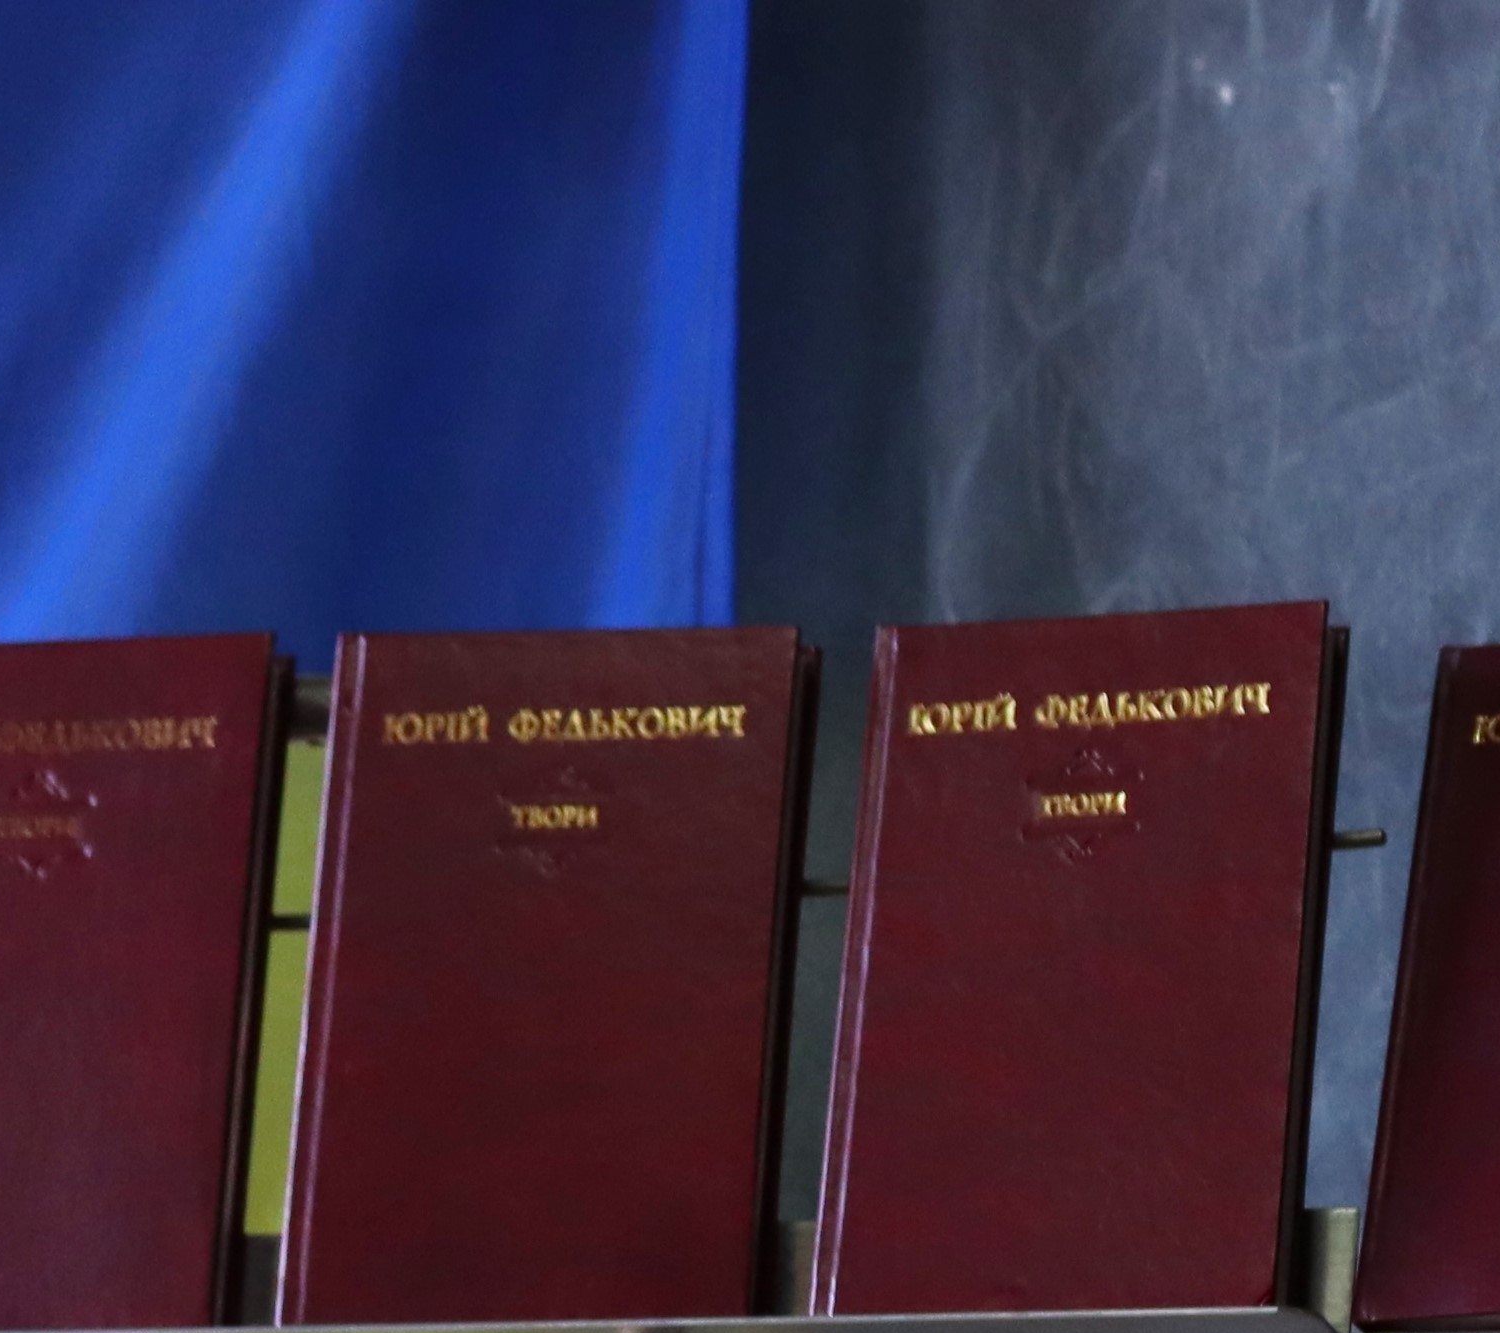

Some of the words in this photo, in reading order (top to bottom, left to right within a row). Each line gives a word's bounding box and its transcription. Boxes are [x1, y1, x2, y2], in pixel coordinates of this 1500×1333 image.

[382, 705, 490, 745] ЮРІЙ
[508, 703, 747, 743] ФЕДЬКОВИЧ
[908, 692, 1018, 735] ЮРІЙ
[1034, 682, 1271, 730] ФЕДЬКОВИЧ
[511, 806, 598, 829] ТВОРИ
[1039, 791, 1127, 818] ТВОРИ
